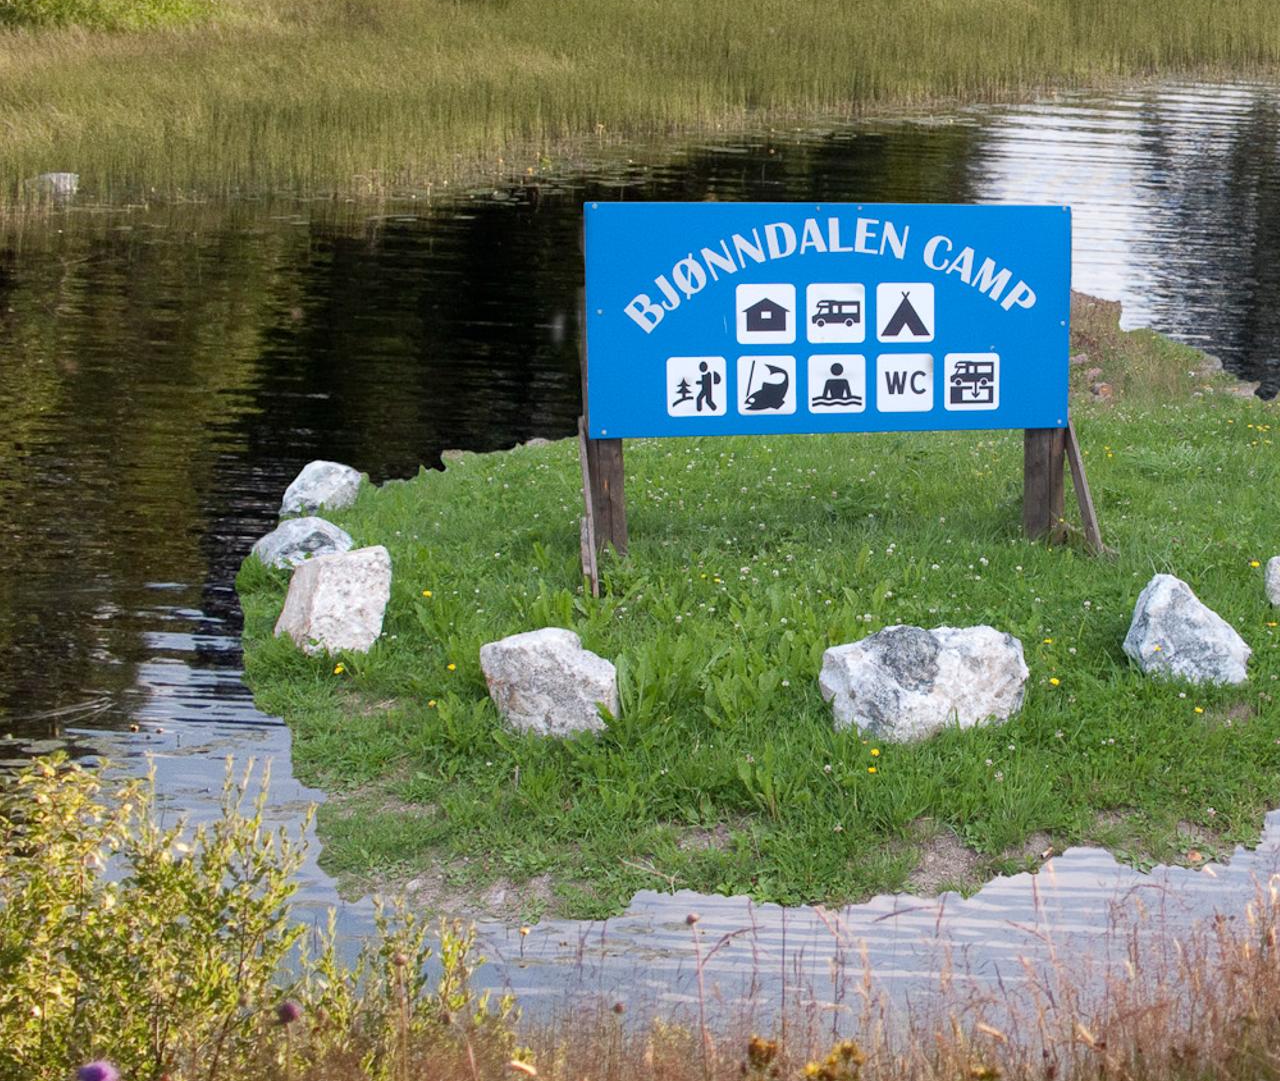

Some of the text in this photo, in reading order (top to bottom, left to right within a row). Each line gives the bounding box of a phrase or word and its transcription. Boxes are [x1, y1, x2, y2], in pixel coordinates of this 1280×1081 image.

[623, 217, 1037, 334] BJØNNDALEN CAMP
[885, 371, 926, 395] WC
